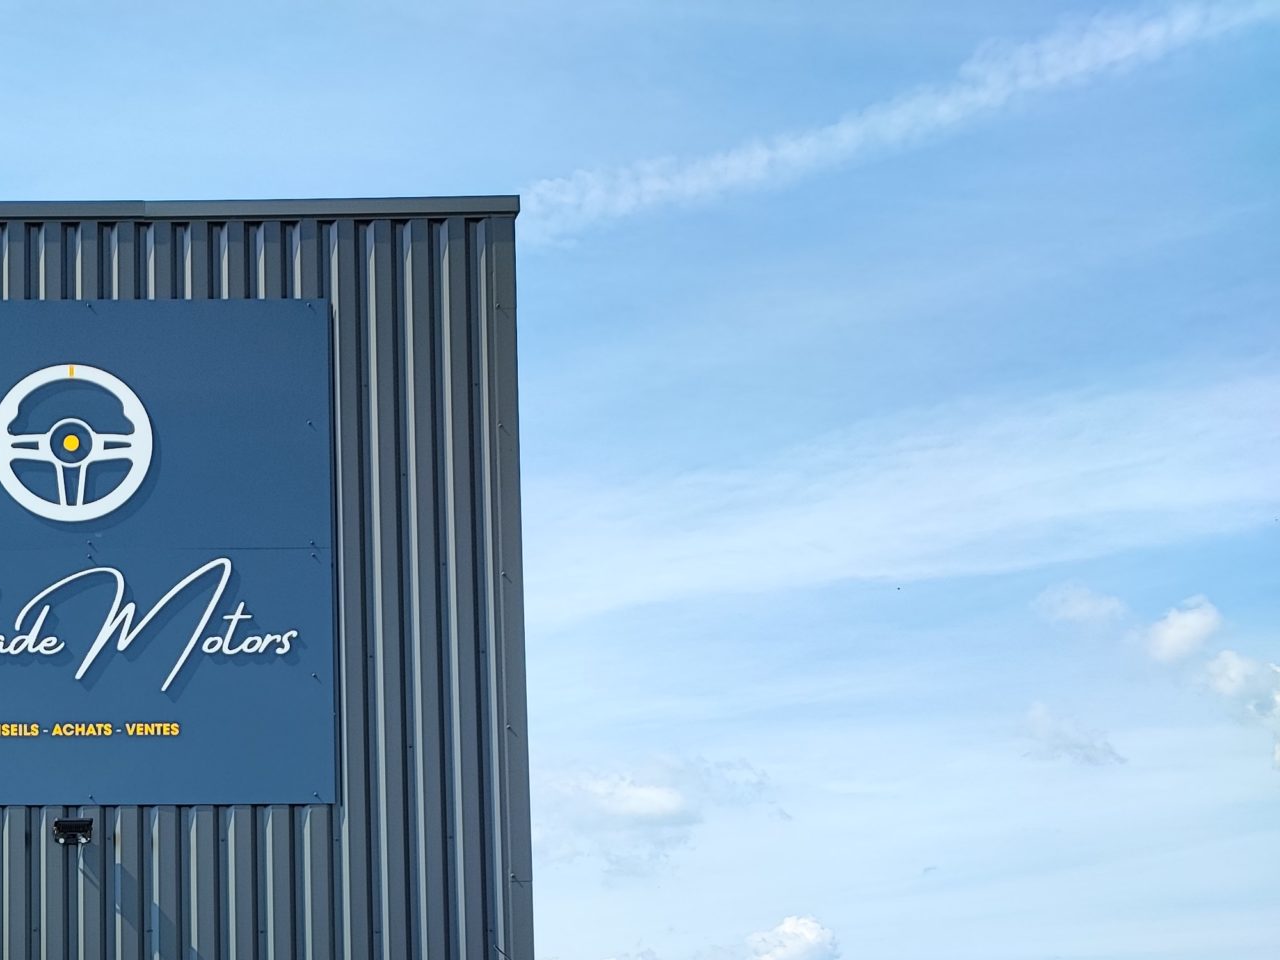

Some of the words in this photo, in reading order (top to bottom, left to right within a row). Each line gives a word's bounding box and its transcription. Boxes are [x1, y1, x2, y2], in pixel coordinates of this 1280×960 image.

[14, 557, 298, 692] Motors
[51, 723, 113, 737] ACHATS
[125, 723, 180, 737] VENTES
